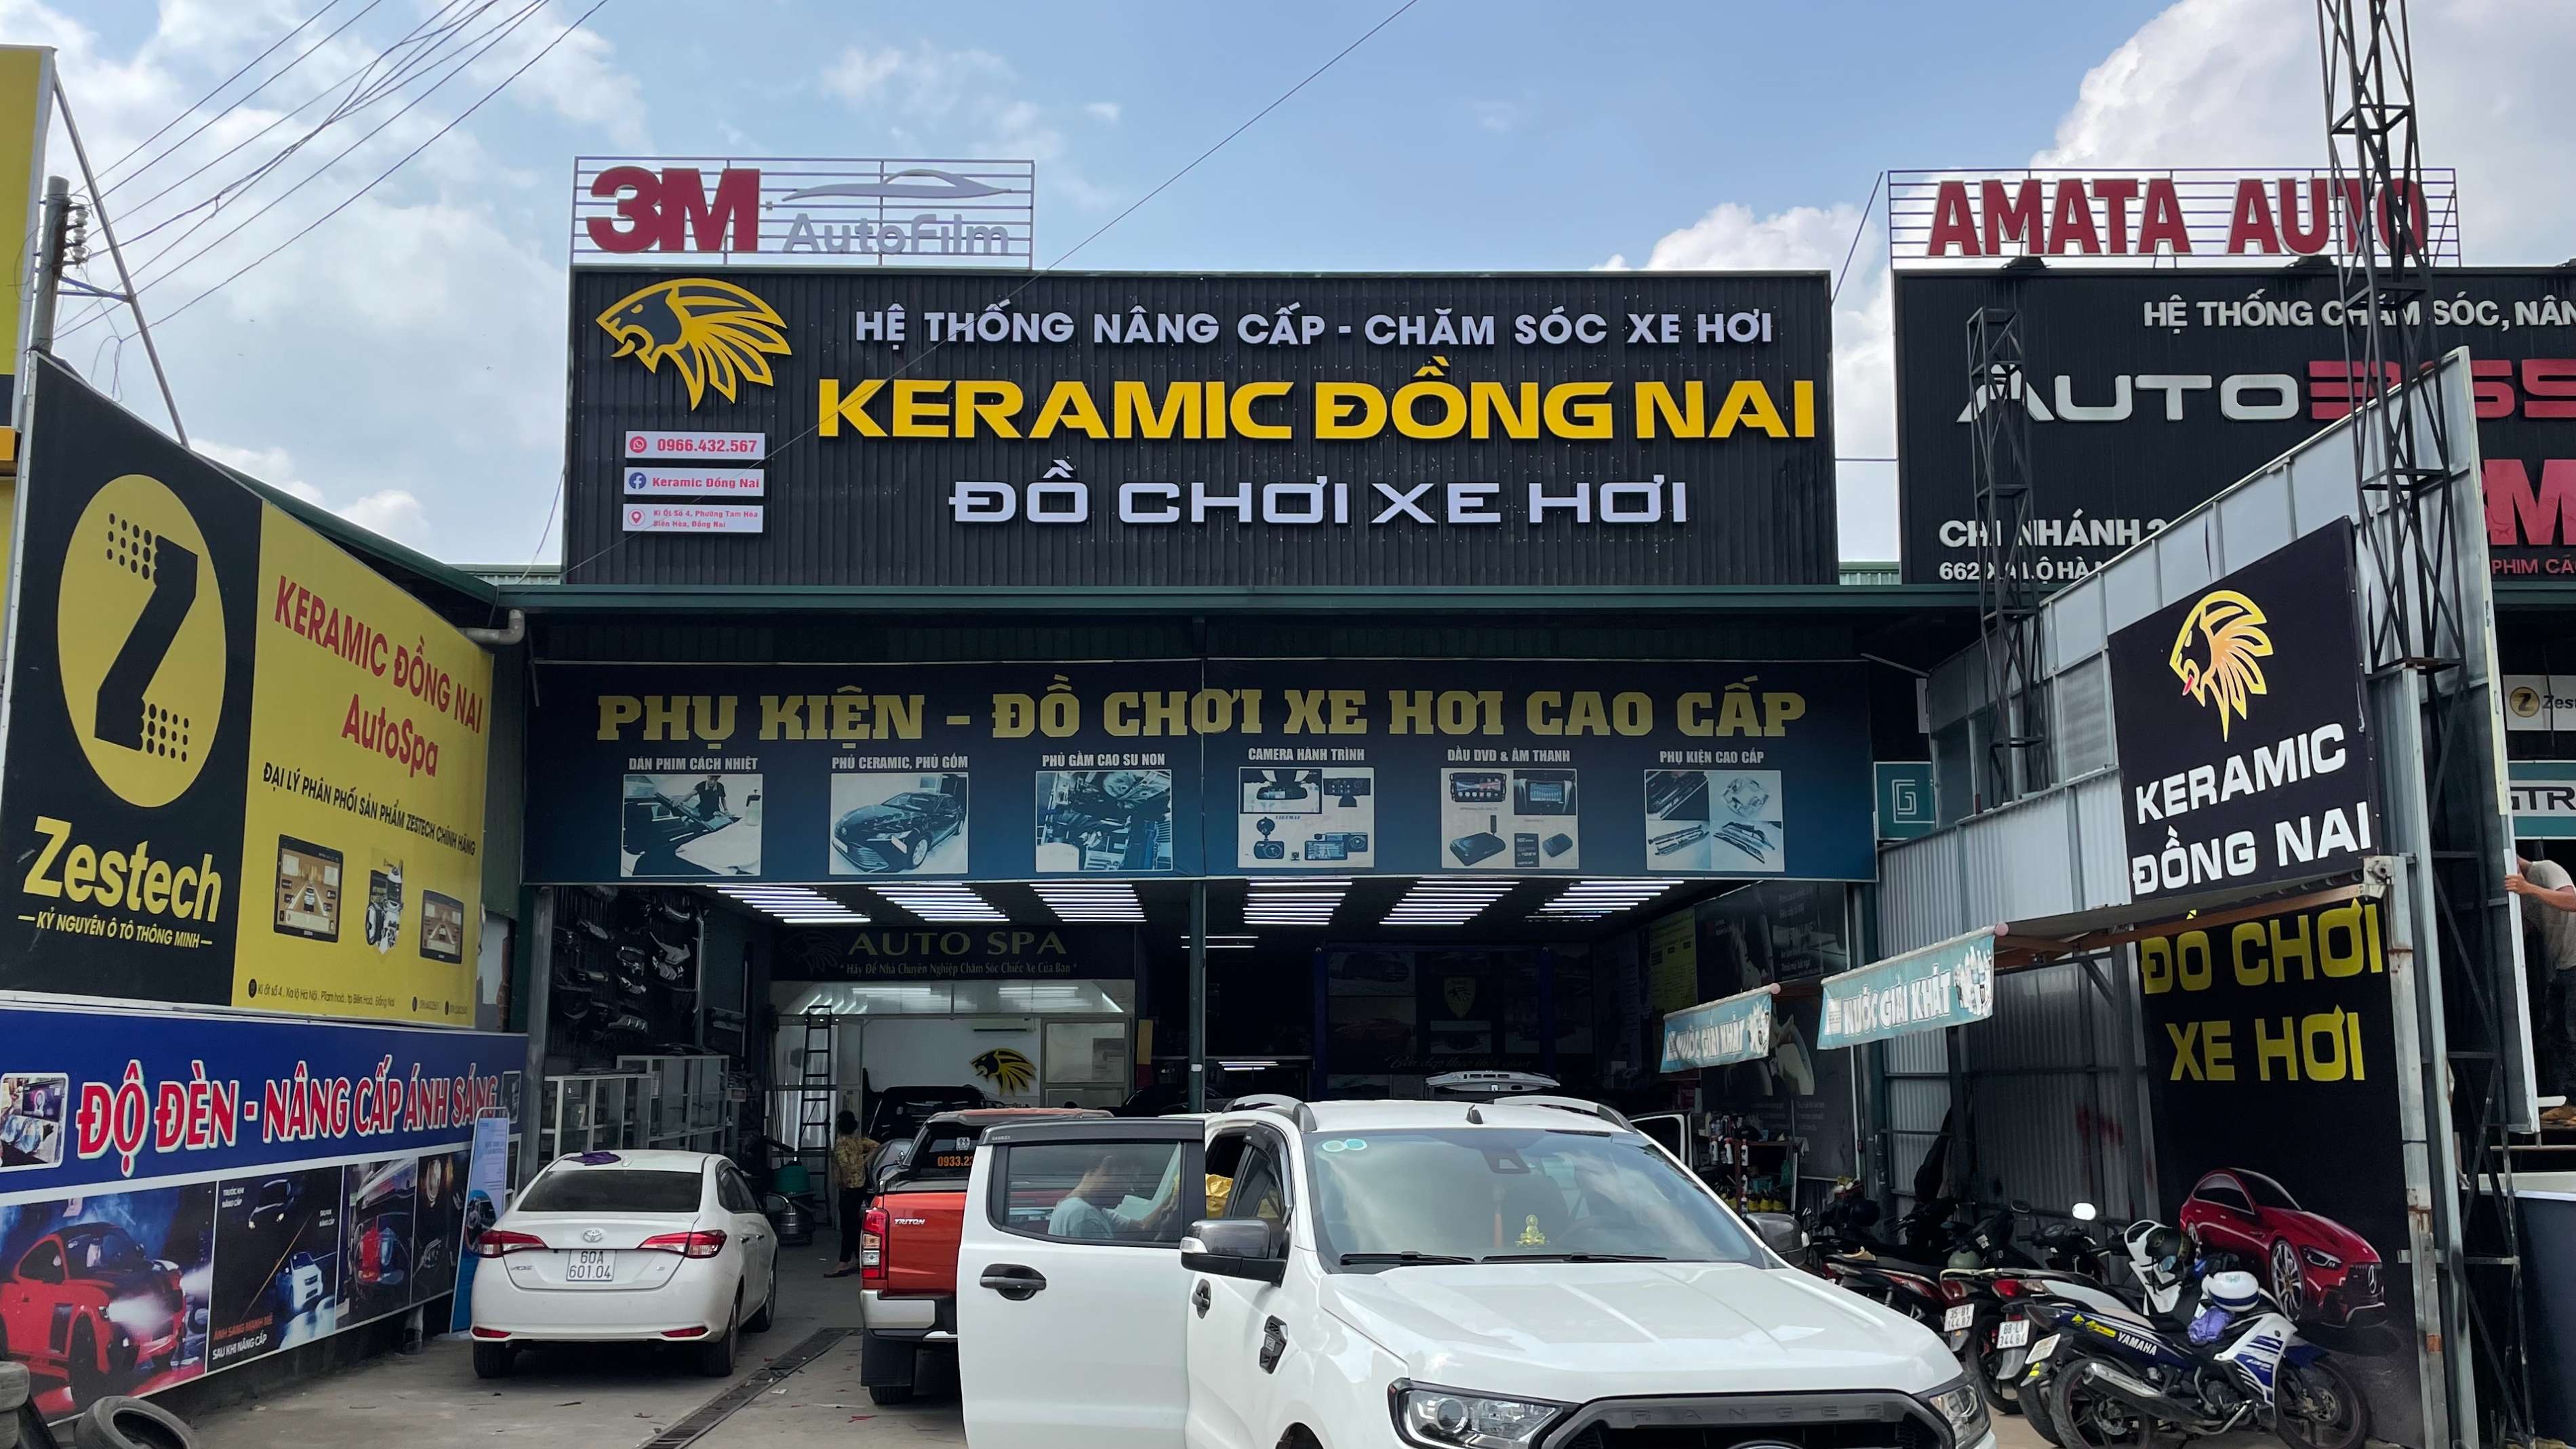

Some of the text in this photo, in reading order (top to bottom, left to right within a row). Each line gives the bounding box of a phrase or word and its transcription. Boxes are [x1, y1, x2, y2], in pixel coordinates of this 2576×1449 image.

[586, 167, 761, 252] 3M
[1925, 177, 2192, 257] AMATA
[2226, 176, 2430, 257] AUTO
[856, 303, 906, 350] HỆ
[925, 299, 1074, 343] THỐNG
[1094, 306, 1220, 344] NÂNG
[1237, 302, 1326, 345] CẤP
[1364, 308, 1495, 346] CHĂM
[1514, 306, 1608, 344] SÓC
[1628, 312, 1680, 344] XE
[1697, 308, 1772, 344] HƠI
[2144, 294, 2188, 335] HỆ
[2196, 288, 2314, 327] THỐNG
[2433, 291, 2510, 332] SÓC,
[819, 356, 1815, 440] KERAMIC ĐỒNG NAI
[657, 438, 758, 453] 0966.432.567
[652, 477, 702, 487] Keramic
[740, 478, 759, 488] Nai
[949, 460, 1687, 524] ĐỒ CHƠI XE HƠI
[2018, 508, 2141, 547] NHÁNH
[1939, 561, 1980, 581] 662
[2492, 553, 2576, 575] PHIM CÁ
[275, 575, 483, 735] KERAMIC ĐỒNG NAI
[597, 695, 738, 750] PHỤ
[759, 685, 925, 749] KIỆN
[992, 674, 1081, 738] ĐỒ
[1103, 687, 1263, 737] CHƠI
[1284, 689, 1368, 735] XE
[1388, 690, 1504, 735] HƠI
[1525, 691, 1653, 736] CAO
[1676, 675, 1807, 737] CẤP
[341, 693, 439, 779] AutoSpa
[1042, 750, 1165, 767] PHỦ GẦM CAO SU NON
[1248, 746, 1365, 762] CAMERA HÀNH TRÌNH
[1474, 749, 1497, 762] DVD
[1500, 751, 1508, 762] &
[1512, 747, 1529, 762] ÂM
[1532, 749, 1571, 762] THANH
[1659, 746, 1765, 766] PHỤ KIỆN CAO CẤP
[656, 757, 686, 771] PHIM
[689, 755, 722, 771] CÁCH
[725, 756, 758, 773] NHIỆT
[832, 752, 969, 771] PHỦ CERAMIC, PHỦ GỐM
[2135, 723, 2346, 825] KERAMIC
[263, 762, 285, 792] ĐẠI
[286, 767, 301, 793] LÝ
[302, 776, 332, 804] PHÂN
[333, 787, 358, 813] PHỐI
[359, 792, 378, 819] SẢN
[379, 799, 406, 830] PHẨM
[405, 813, 436, 840] ZESTECH
[436, 825, 458, 850] CHÍNH
[23, 815, 222, 923] Zestech
[2132, 801, 2371, 895] ĐỒNG NAI
[36, 906, 201, 948] KỶ NGUYÊN Ô TÔ THÔNG MINH
[847, 931, 1068, 956] AUTO SPA
[2232, 897, 2383, 987] CHƠI
[1843, 983, 1878, 1037] NƯỚC
[1910, 963, 1950, 1021] KHÁT
[2165, 1004, 2364, 1082] XE HƠI
[76, 1059, 148, 1177] ĐỘ
[154, 1059, 239, 1152] ĐÈN
[263, 1060, 350, 1145] NÂNG
[353, 1054, 403, 1136] CẤP
[403, 1063, 449, 1132] ÁNH
[449, 1063, 498, 1126] SÁNG
[569, 1265, 611, 1279] 601.04
[580, 1250, 603, 1264] 60A
[2117, 1331, 2158, 1356] YAMAHA
[1631, 1404, 1883, 1422] RANGER
